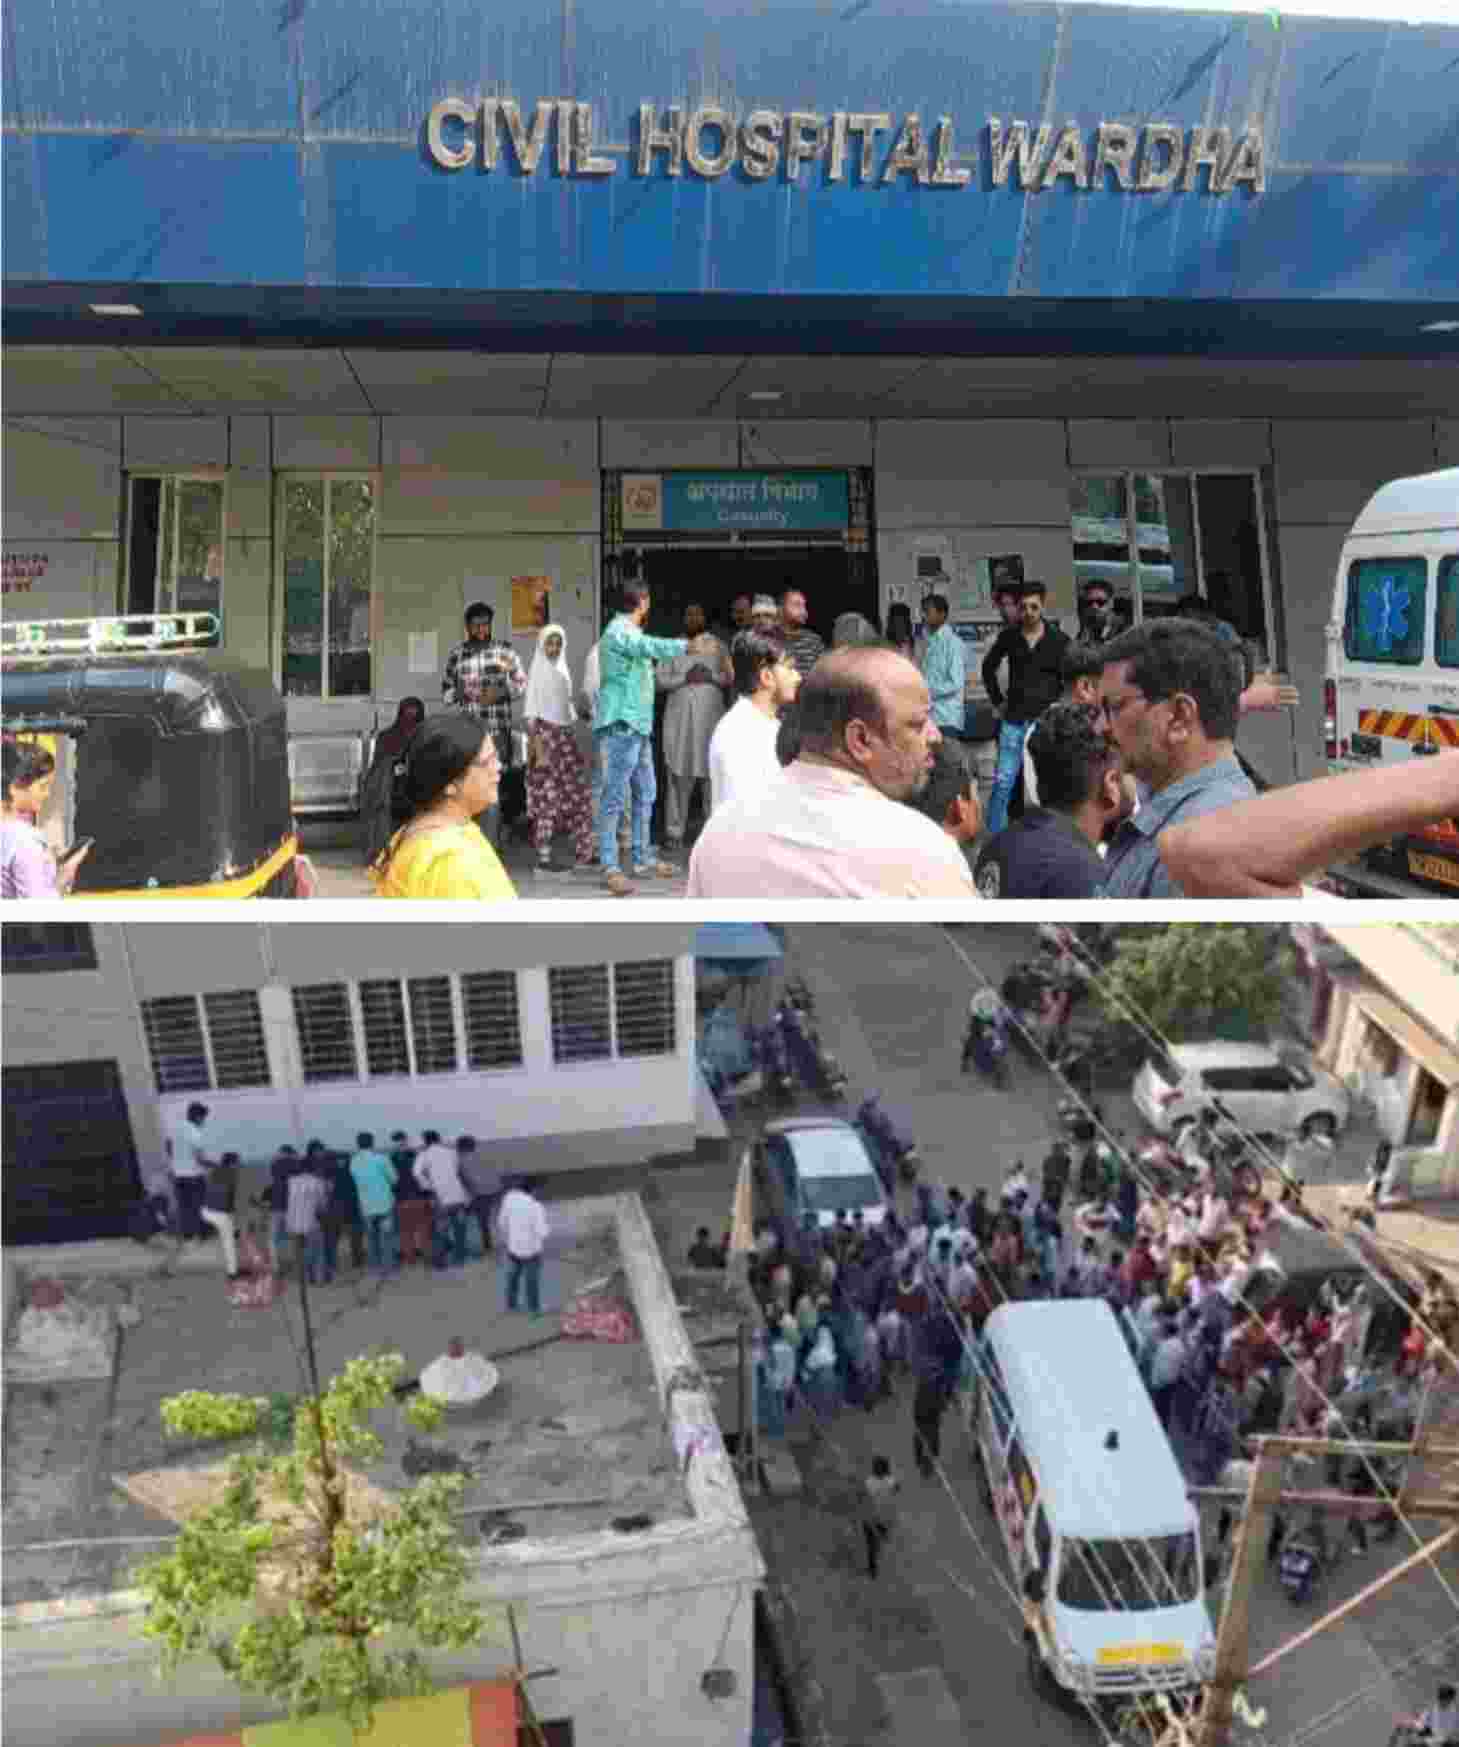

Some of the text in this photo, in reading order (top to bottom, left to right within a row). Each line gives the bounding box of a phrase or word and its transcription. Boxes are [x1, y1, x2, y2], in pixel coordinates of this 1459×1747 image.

[427, 97, 1266, 193] CIVIL HOSPITAL WARDHA
